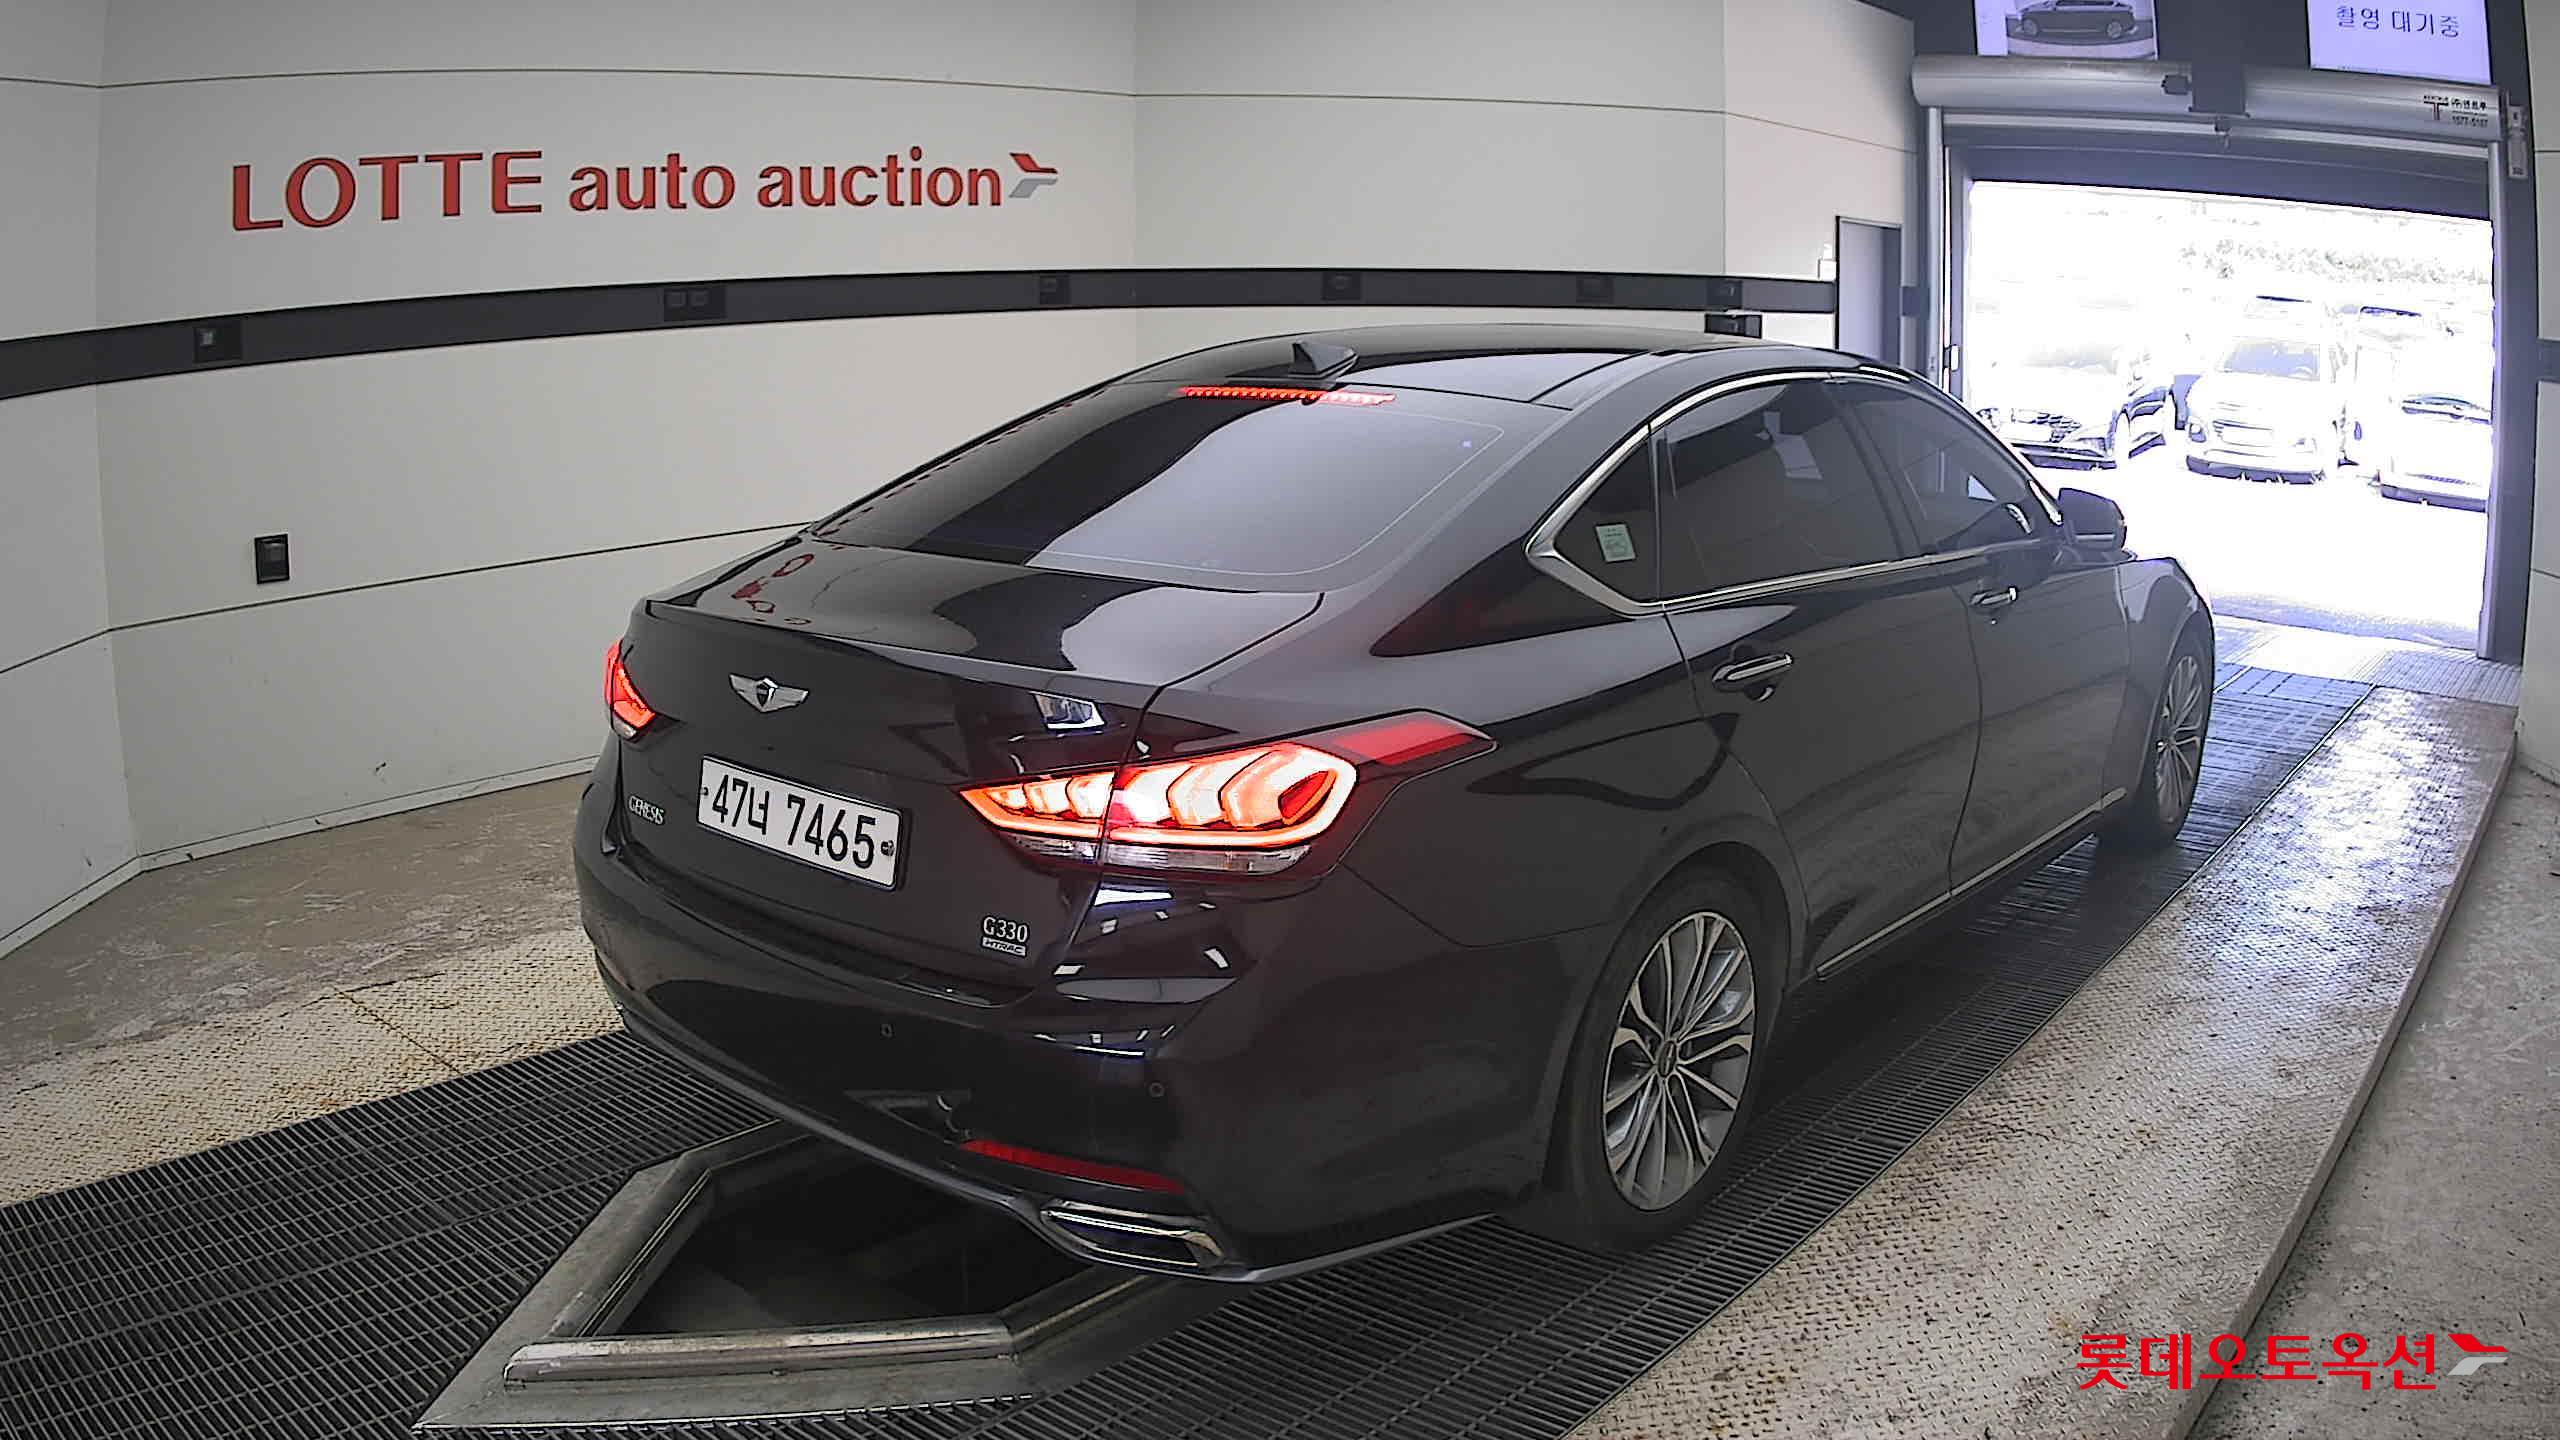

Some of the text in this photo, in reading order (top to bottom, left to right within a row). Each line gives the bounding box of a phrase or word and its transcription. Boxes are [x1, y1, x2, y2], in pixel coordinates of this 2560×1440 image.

[2336, 6, 2459, 38] 촬영 대기중
[233, 146, 1002, 231] LOTTE auto auction
[712, 774, 877, 869] 47너 7465
[983, 916, 1028, 943] G330
